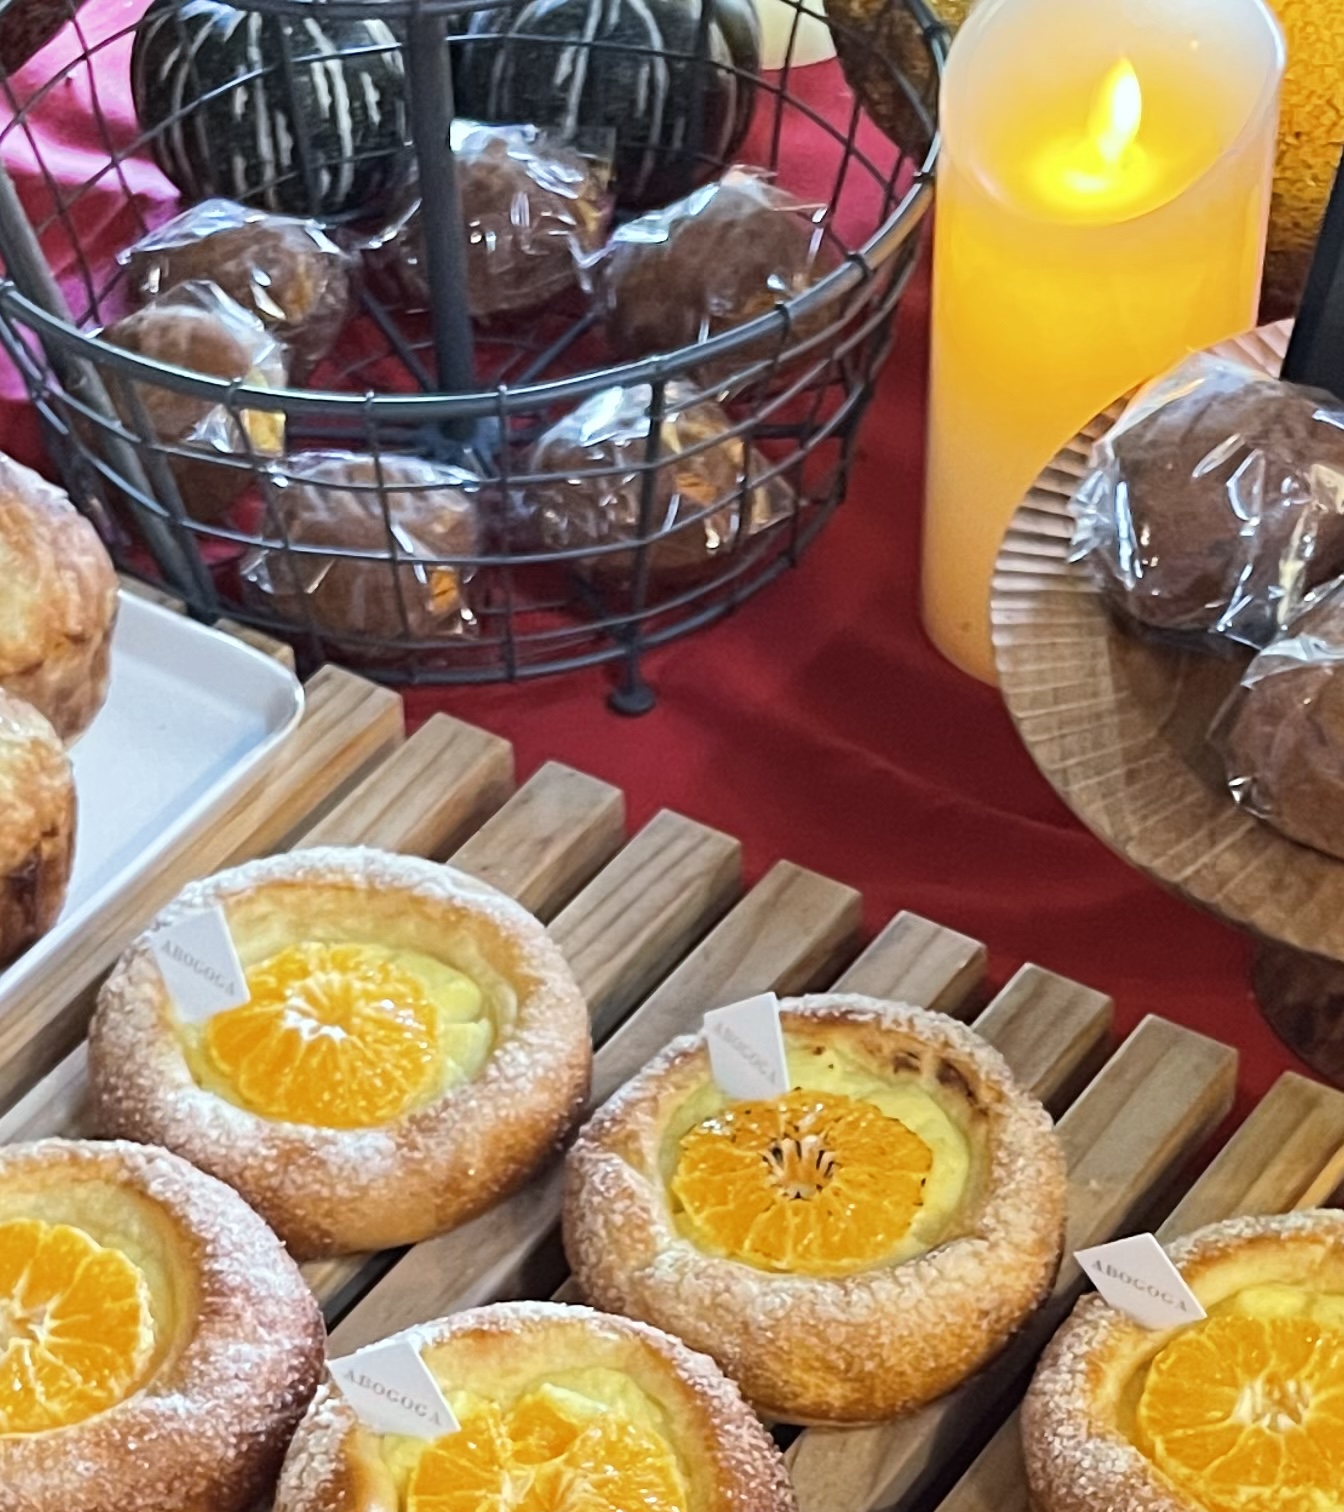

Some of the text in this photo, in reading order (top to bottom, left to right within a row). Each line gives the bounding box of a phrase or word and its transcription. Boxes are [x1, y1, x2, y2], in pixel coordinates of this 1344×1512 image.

[160, 938, 237, 997] ABOGOGA
[1091, 1259, 1188, 1313] ABOGOGA
[344, 1367, 442, 1426] ABOGOGA
